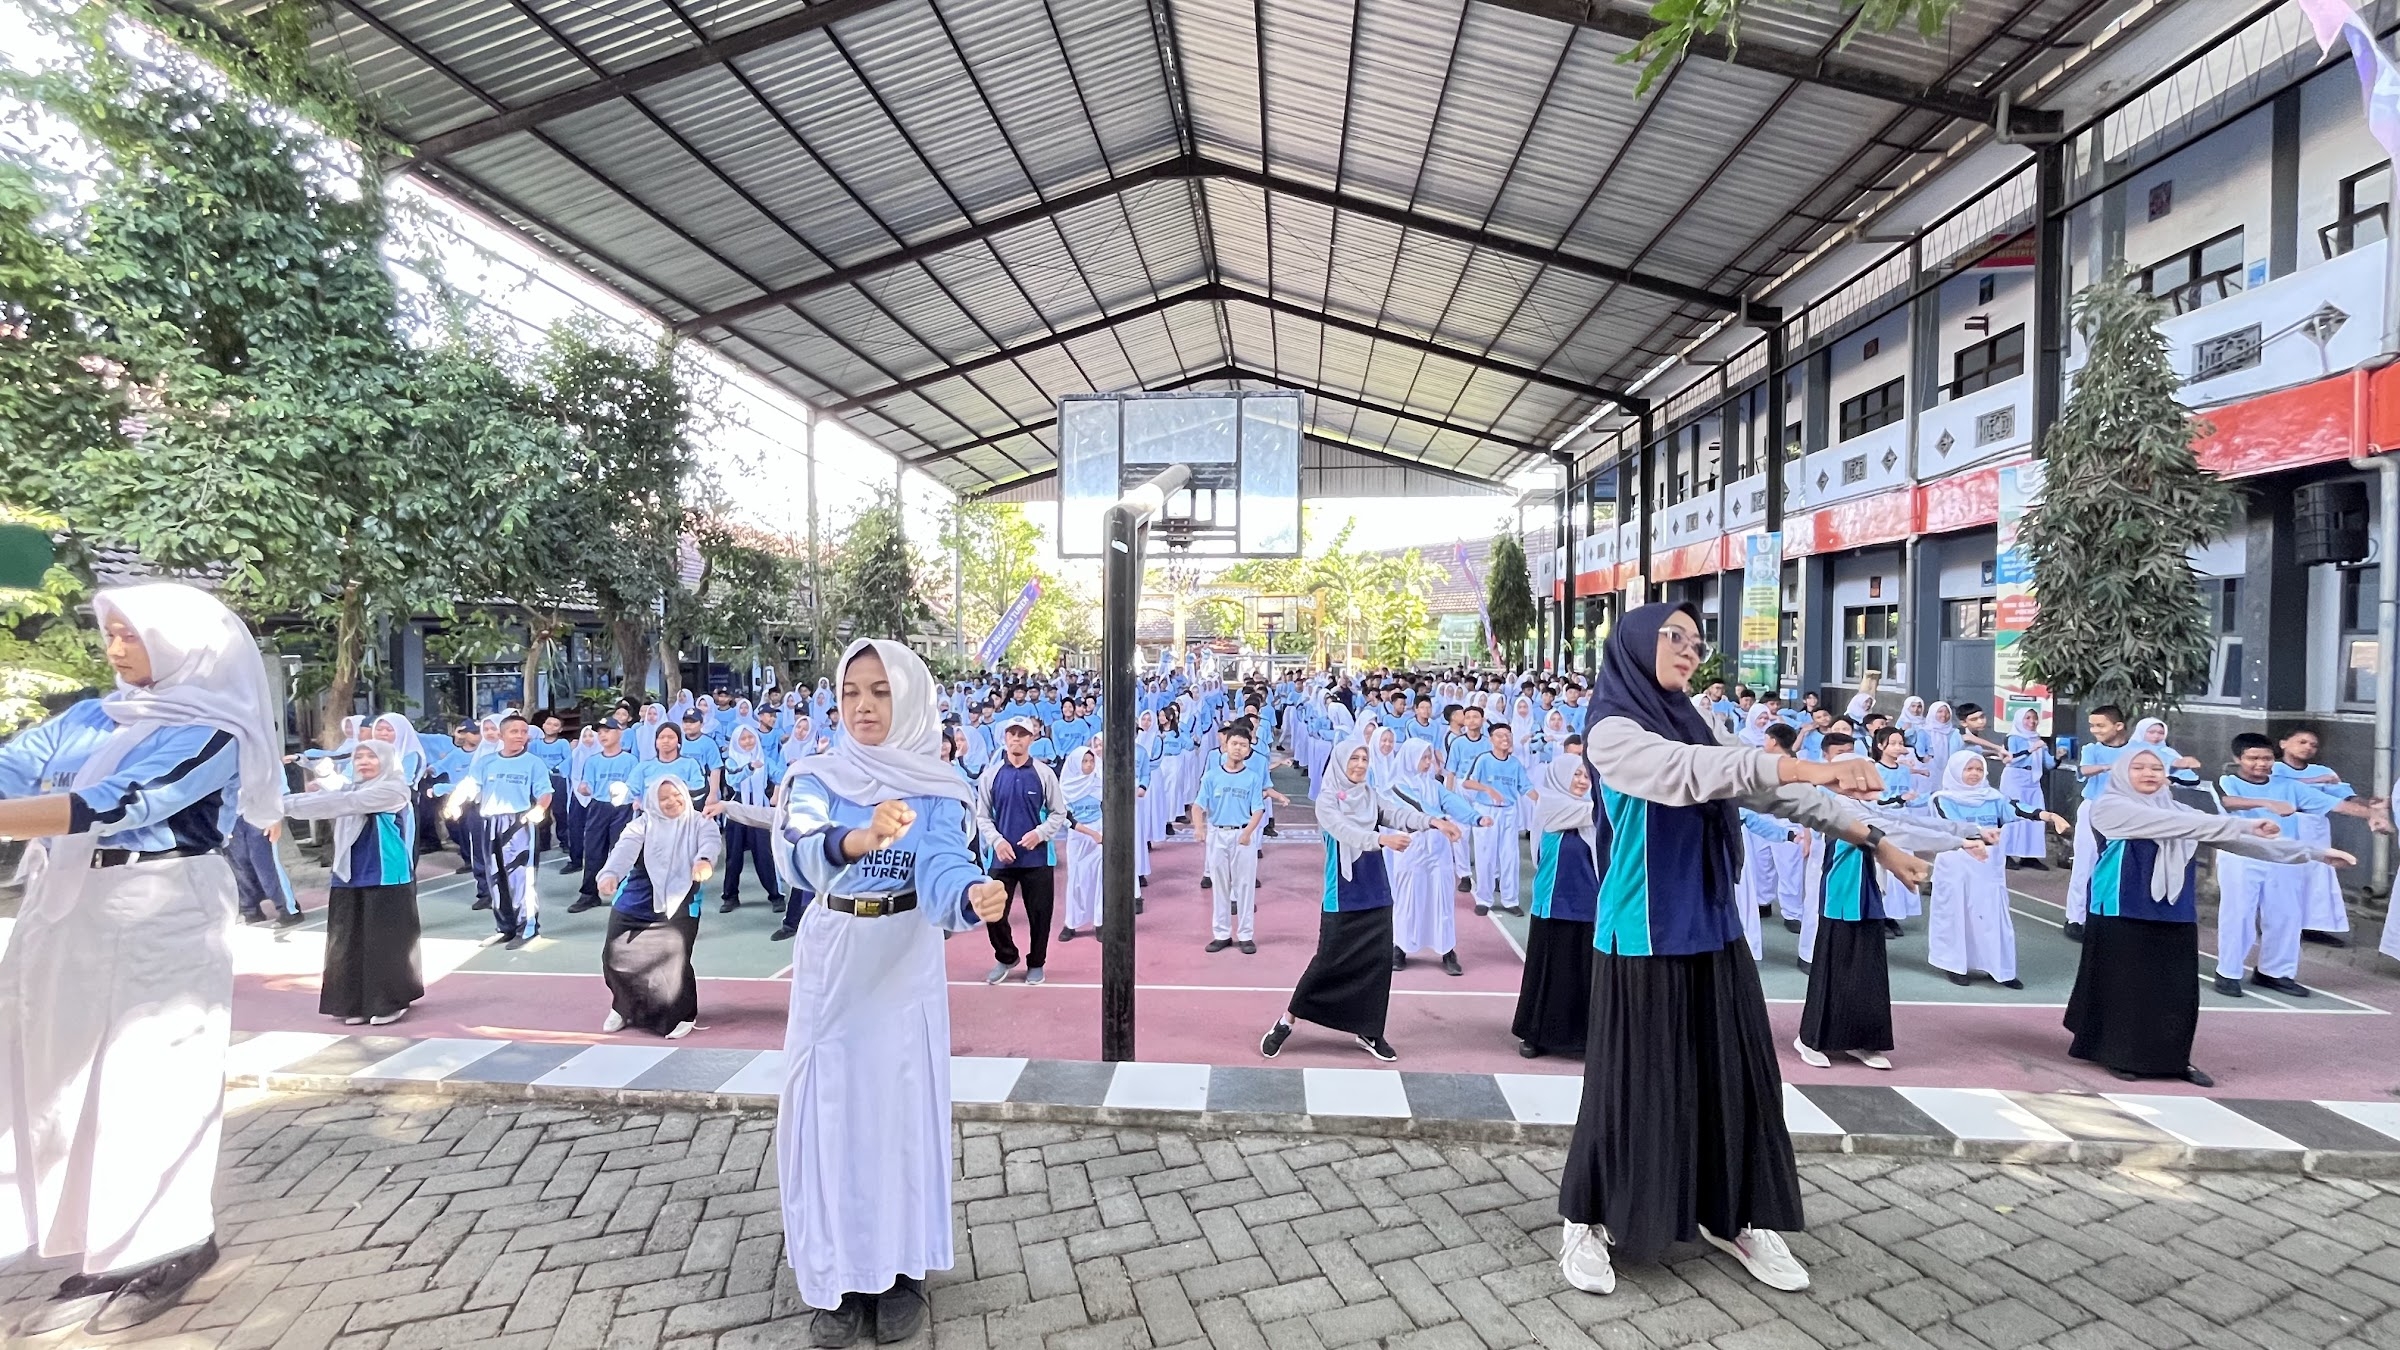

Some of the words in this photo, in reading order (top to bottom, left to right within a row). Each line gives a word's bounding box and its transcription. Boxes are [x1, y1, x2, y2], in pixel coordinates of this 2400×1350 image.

[982, 642, 993, 660] SMP
[991, 620, 1012, 645] NEGERI
[1011, 595, 1030, 619] TUREN
[863, 848, 916, 869] NEGERI
[861, 866, 910, 881] TUREN
